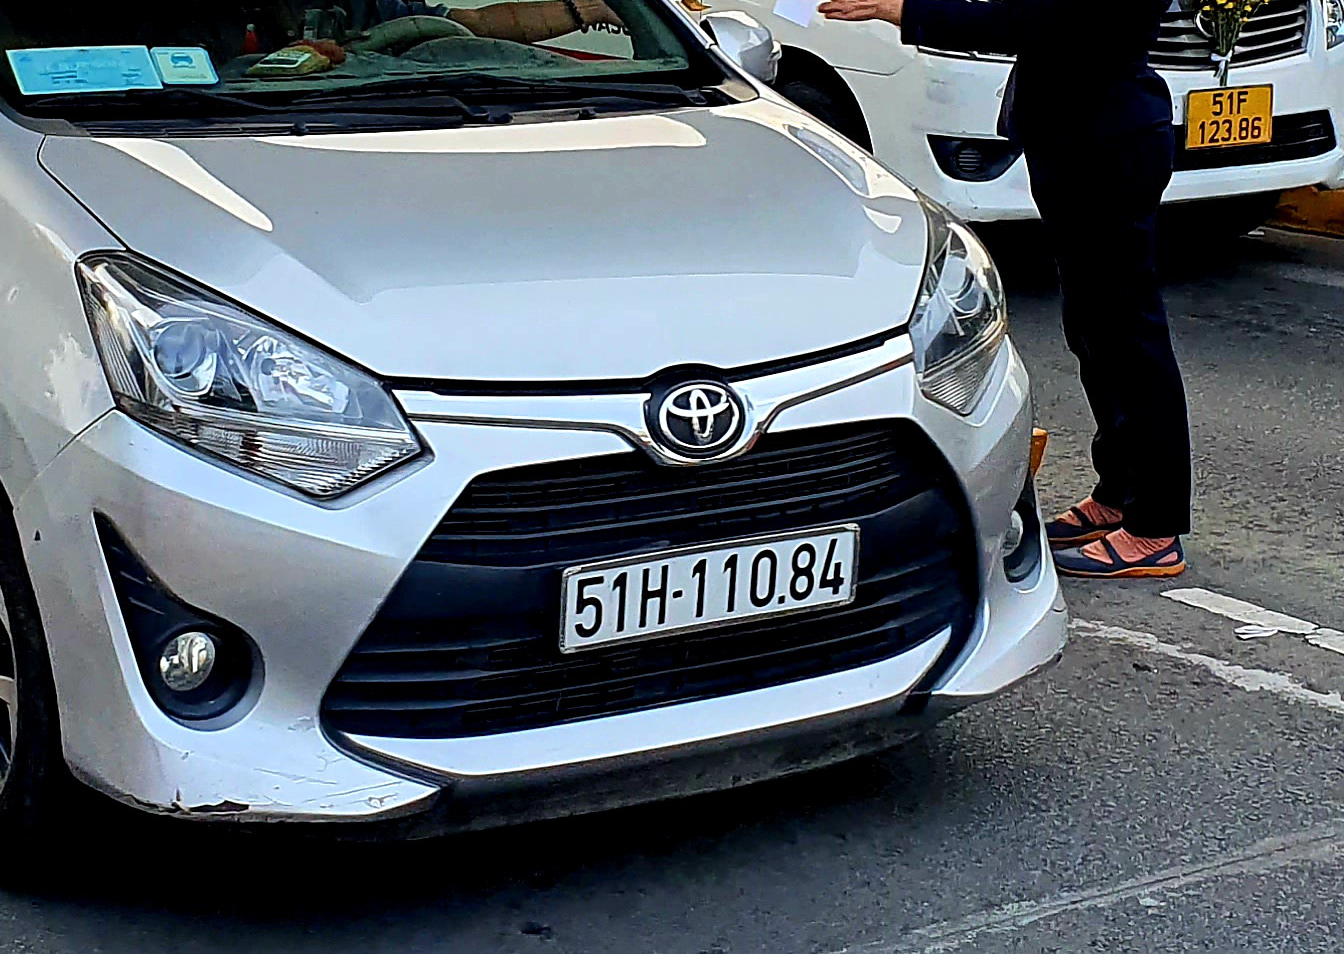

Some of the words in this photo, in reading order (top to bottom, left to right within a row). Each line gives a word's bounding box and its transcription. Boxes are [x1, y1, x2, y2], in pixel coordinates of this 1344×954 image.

[1211, 91, 1249, 116] 51F
[1198, 116, 1262, 145] 123.86
[574, 538, 845, 638] 51H-110.84
